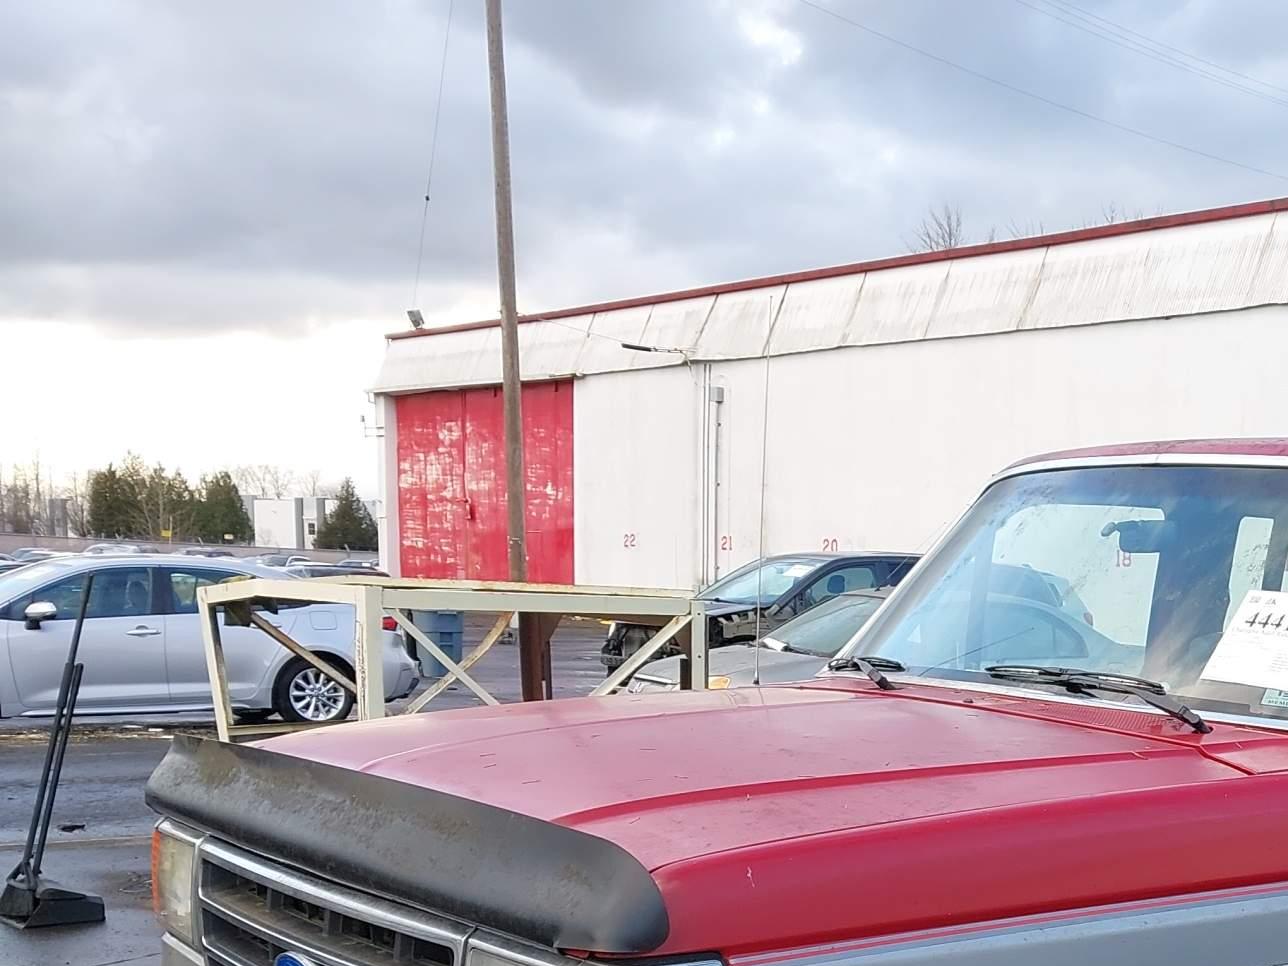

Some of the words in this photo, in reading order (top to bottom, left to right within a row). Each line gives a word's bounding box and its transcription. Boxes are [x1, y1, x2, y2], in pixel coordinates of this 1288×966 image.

[623, 533, 636, 548] 22
[721, 535, 733, 551] 21
[822, 538, 839, 552] 20
[1116, 549, 1132, 568] 18
